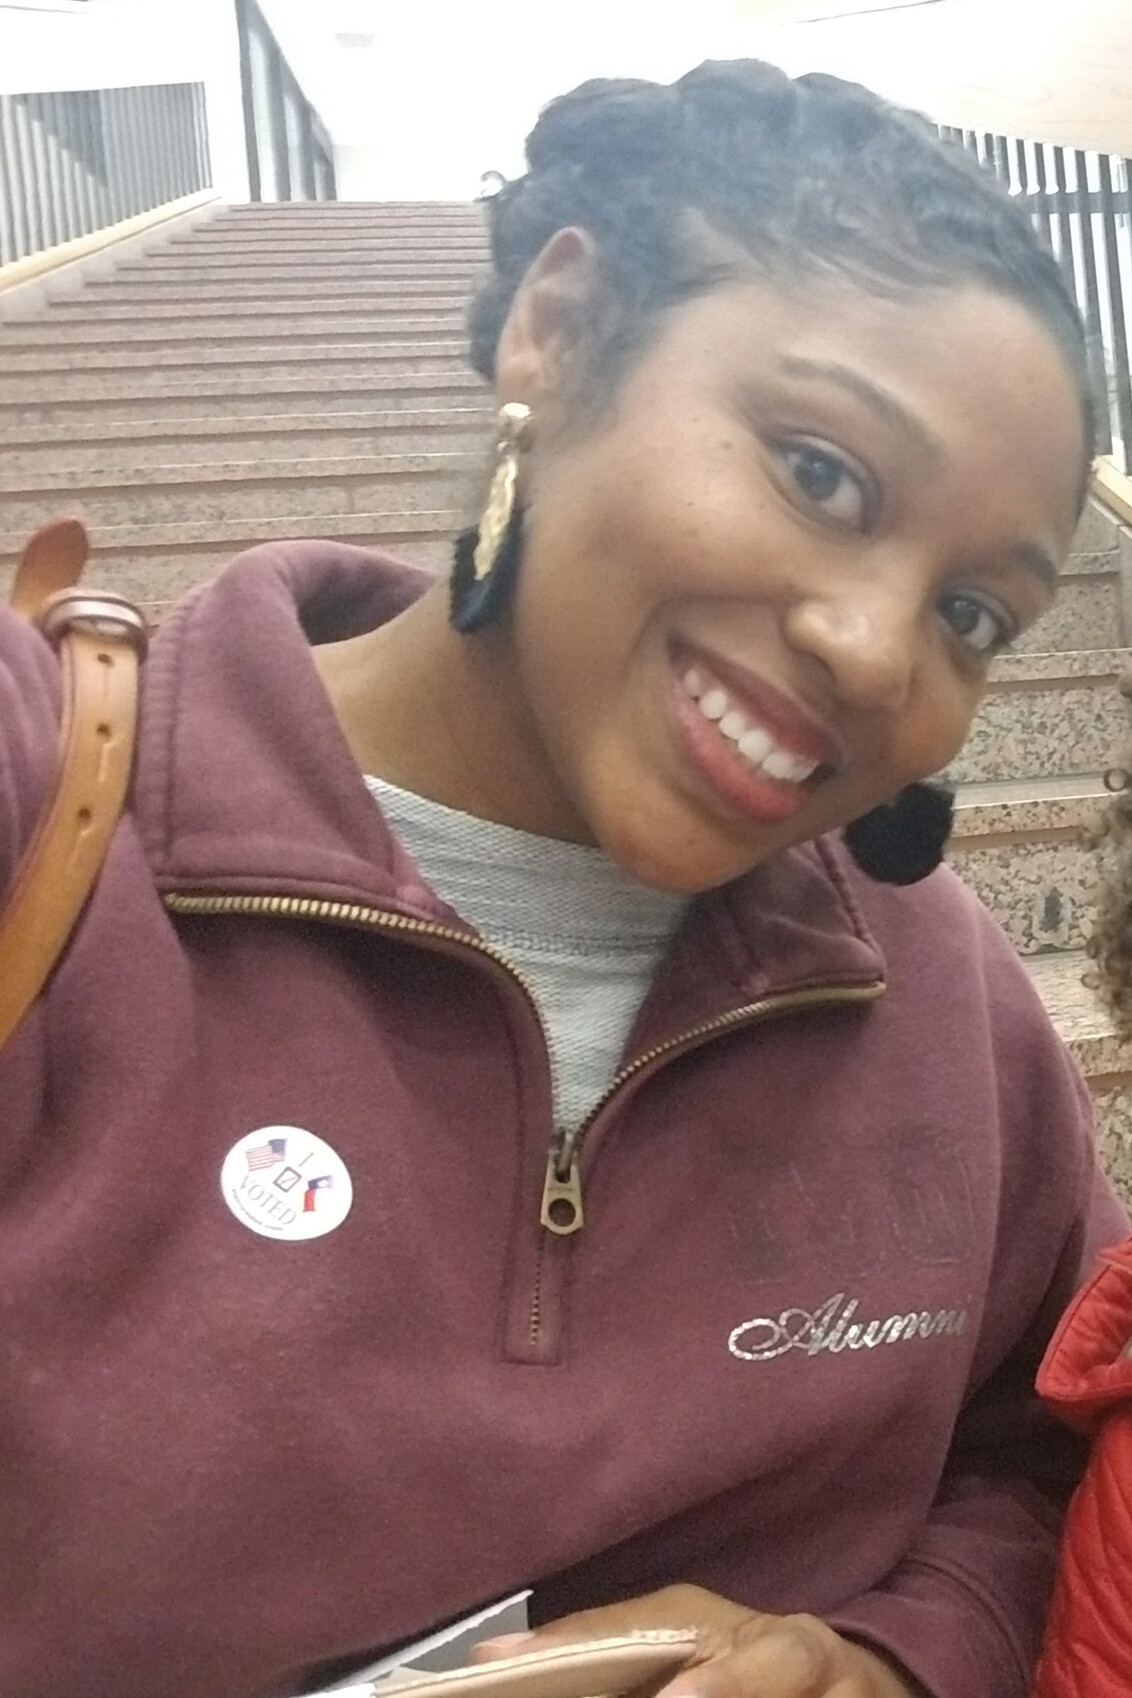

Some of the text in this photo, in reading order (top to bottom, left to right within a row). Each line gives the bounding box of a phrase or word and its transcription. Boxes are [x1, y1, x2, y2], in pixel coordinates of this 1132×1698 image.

[298, 1151, 315, 1168] I
[239, 1174, 297, 1226] VOTED
[728, 1292, 972, 1361] Alumni
